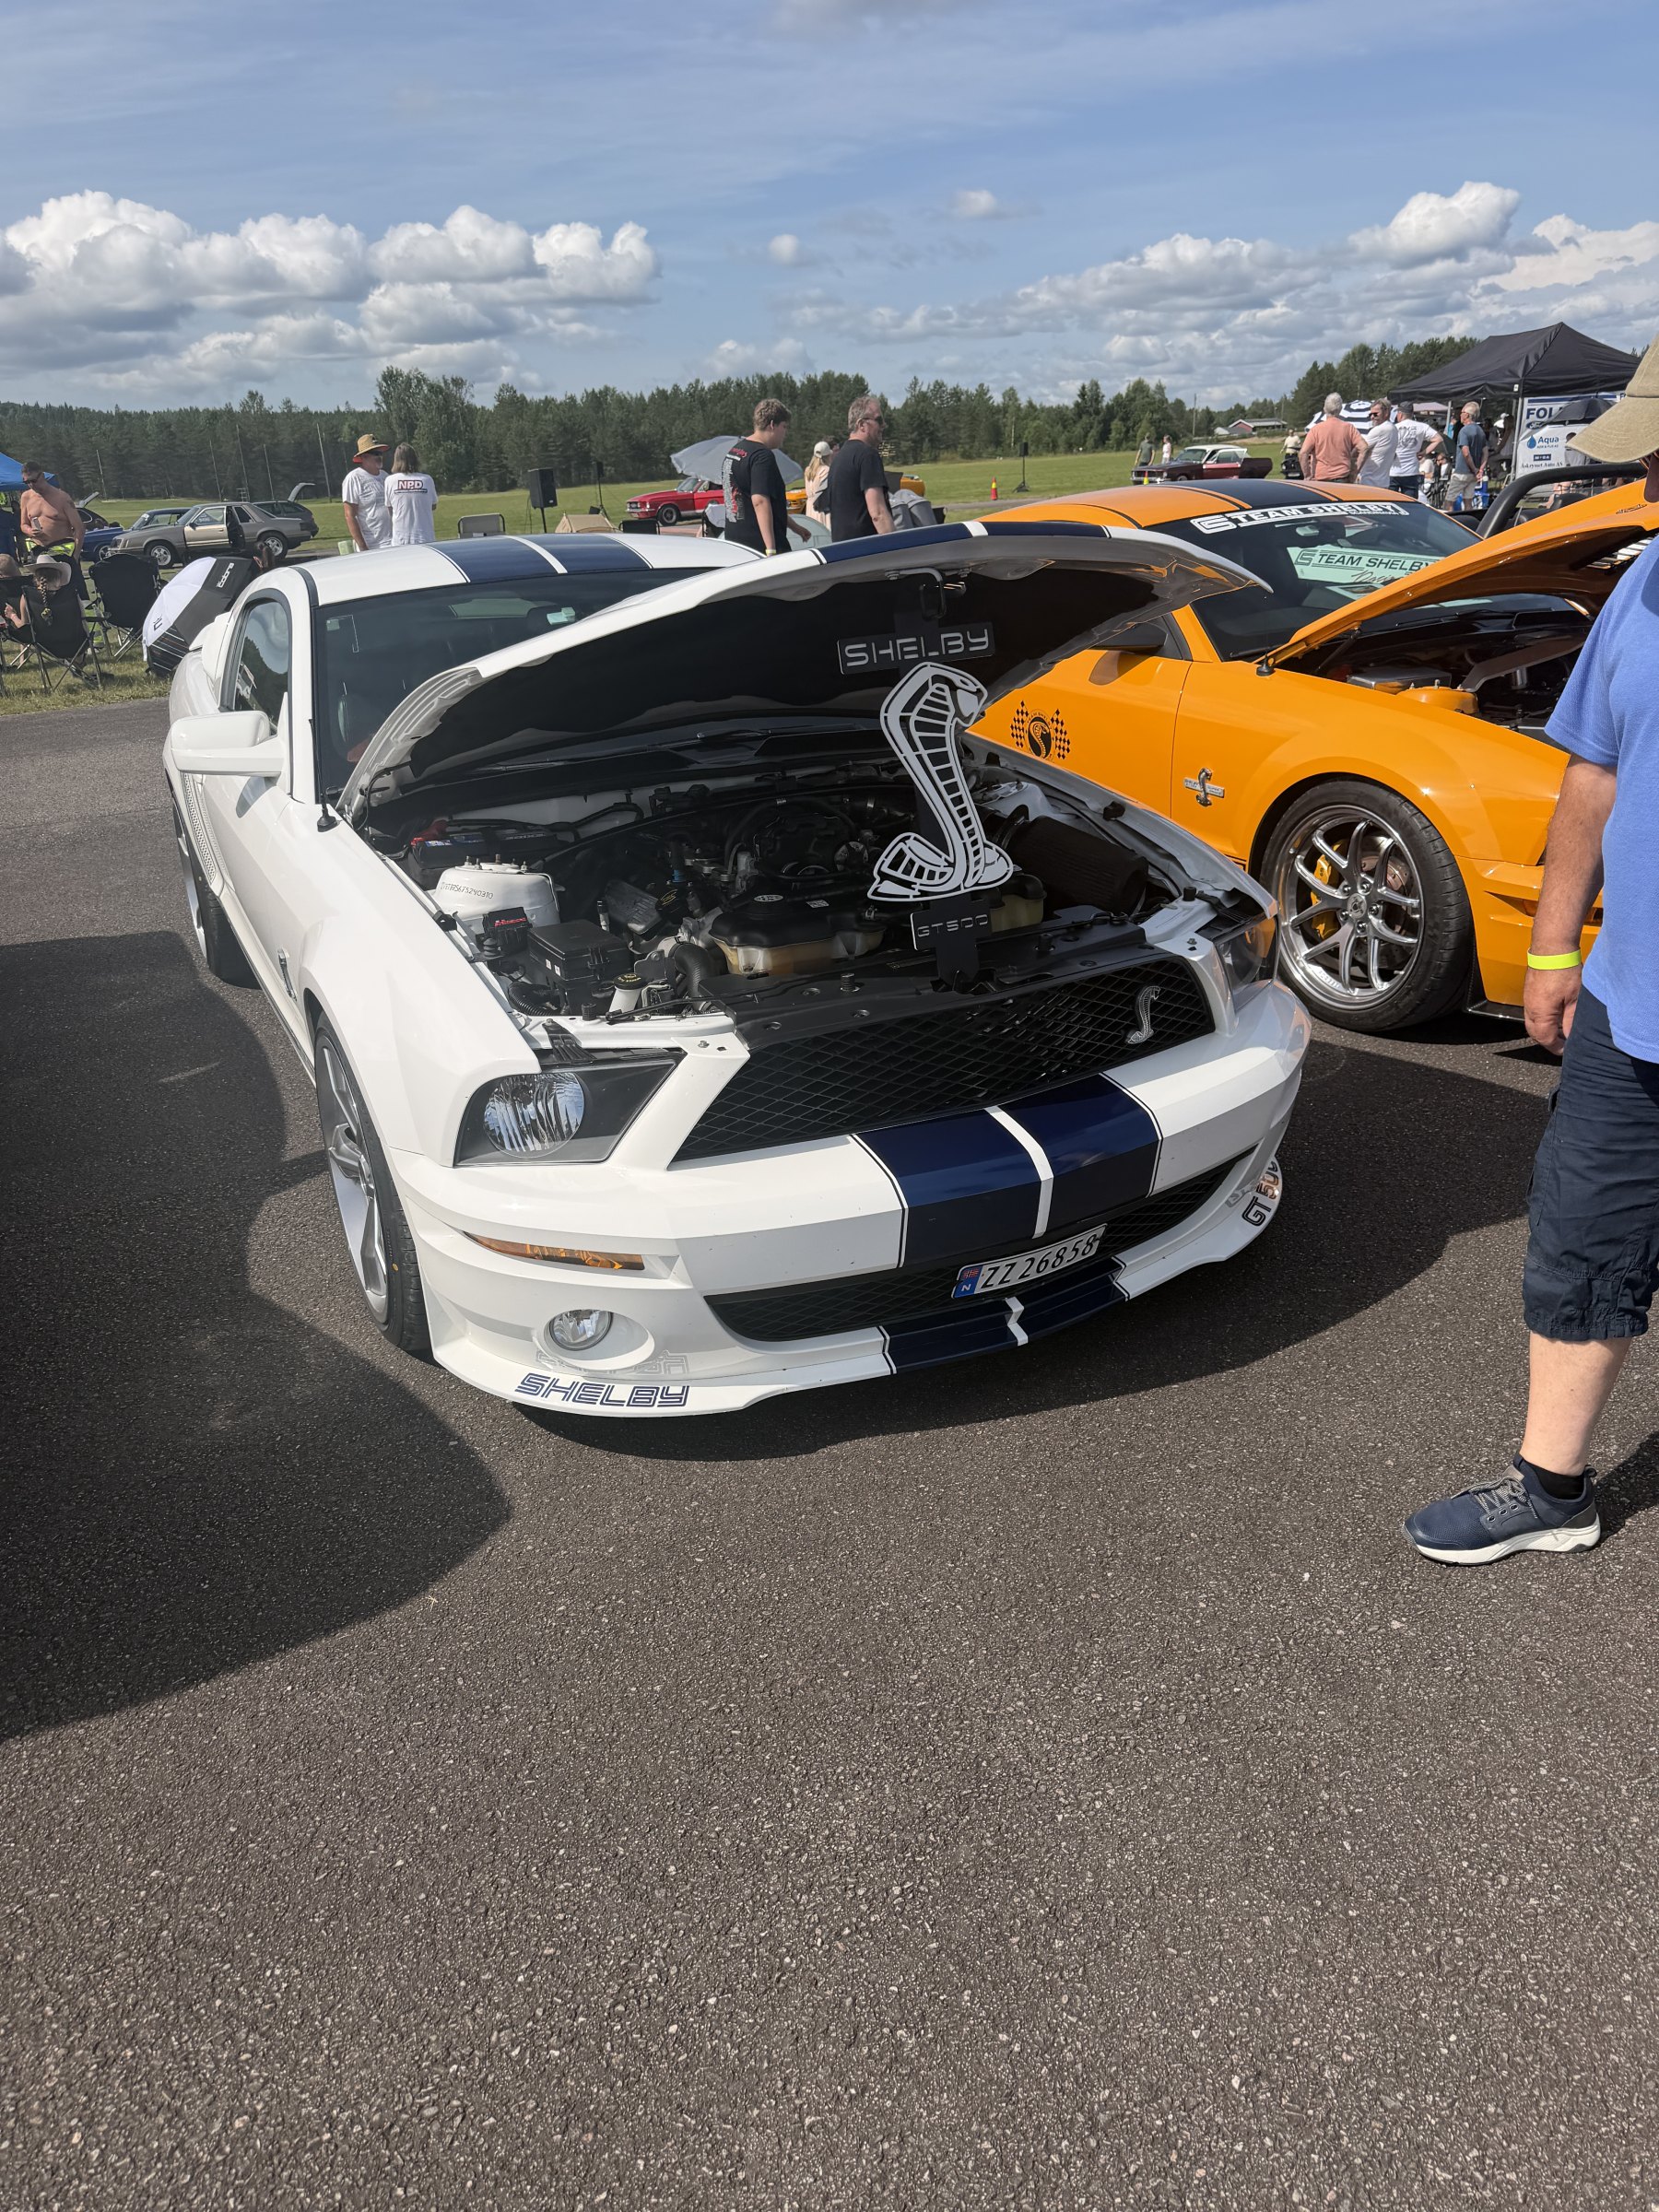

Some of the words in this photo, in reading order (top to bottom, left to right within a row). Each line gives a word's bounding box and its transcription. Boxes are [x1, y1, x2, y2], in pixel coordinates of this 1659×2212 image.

[1537, 435, 1559, 445] Aqua
[398, 479, 424, 489] NPD
[1230, 507, 1304, 523] TEAM
[1307, 504, 1394, 513] SHELBY
[1317, 553, 1363, 567] TEAM
[844, 629, 989, 667] SHELBY
[917, 914, 988, 937] GT500
[981, 1261, 1017, 1288] ZZ
[1018, 1233, 1098, 1280] 26858
[960, 1283, 971, 1292] N
[514, 1372, 690, 1407] SHELBY
